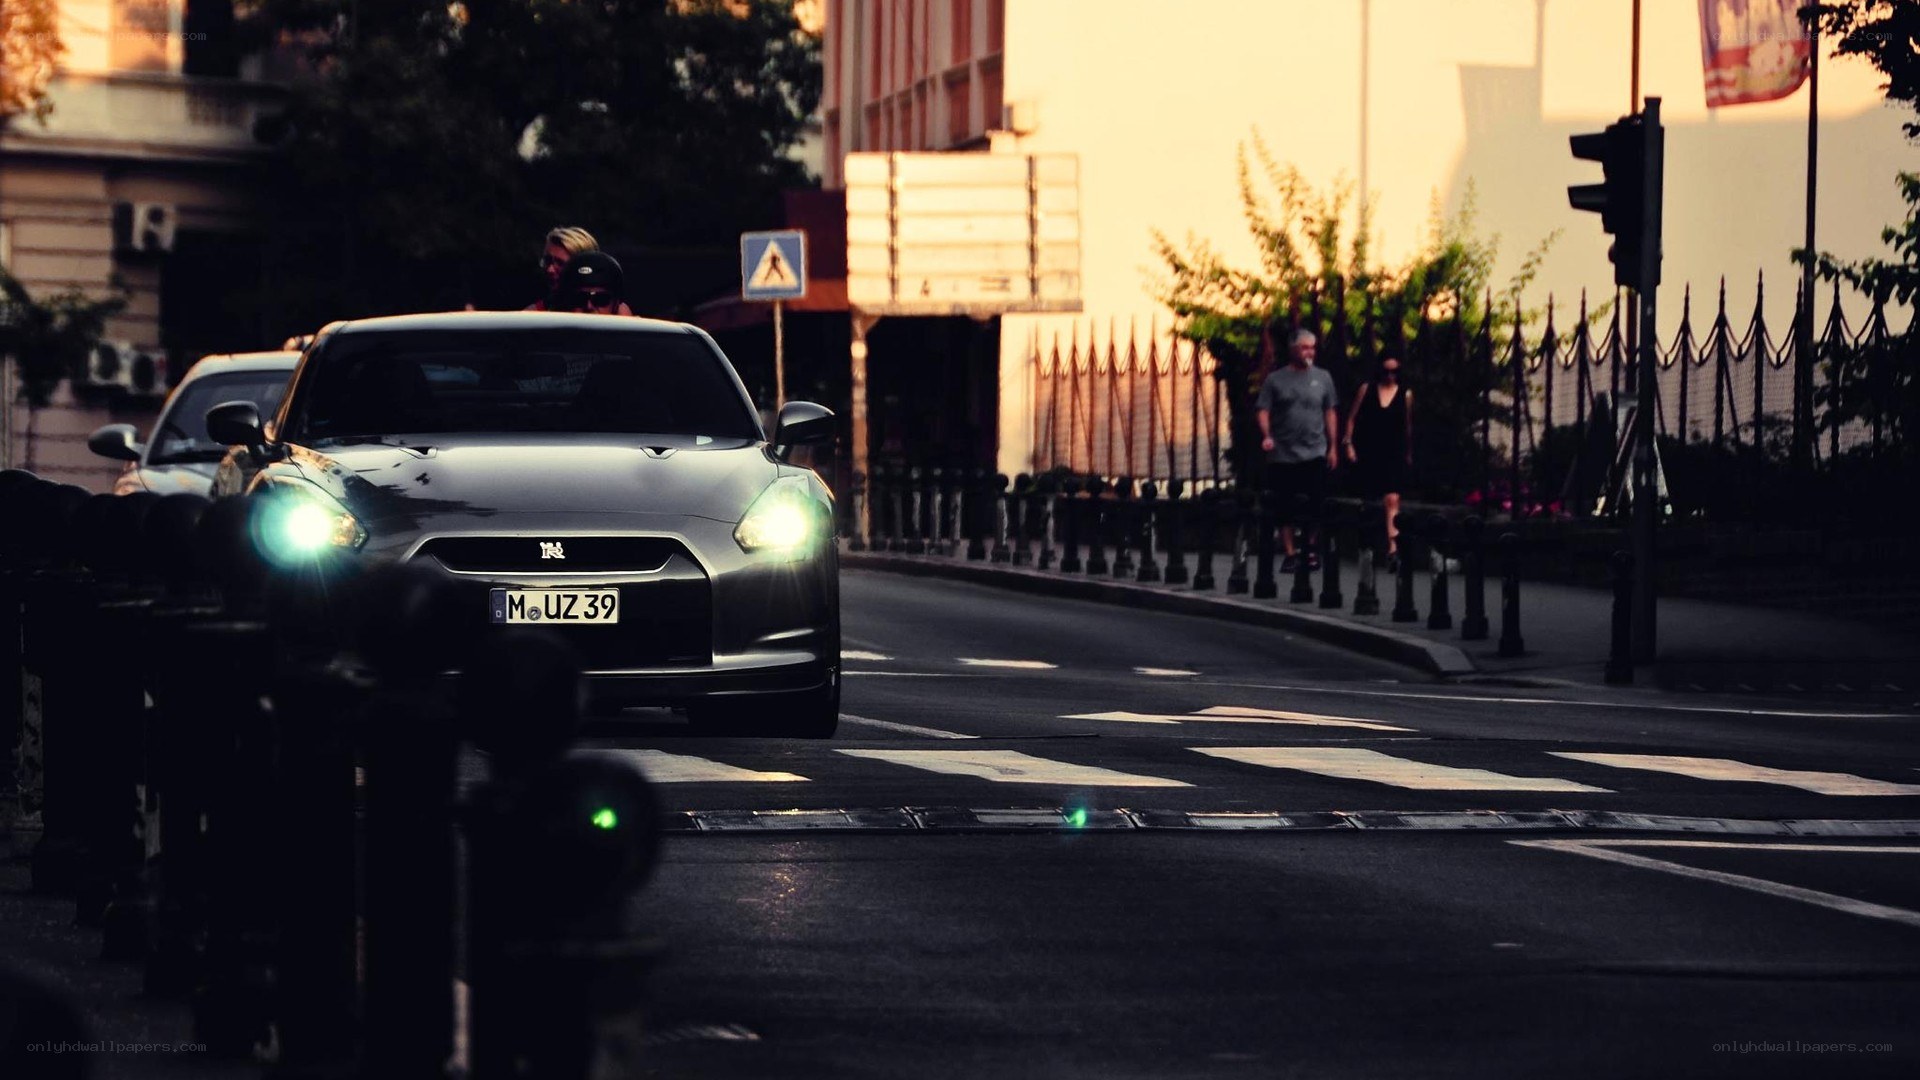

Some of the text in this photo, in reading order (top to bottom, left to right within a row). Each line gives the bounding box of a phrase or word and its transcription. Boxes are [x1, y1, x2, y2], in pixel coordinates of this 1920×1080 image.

[508, 594, 616, 619] M UZ 39
